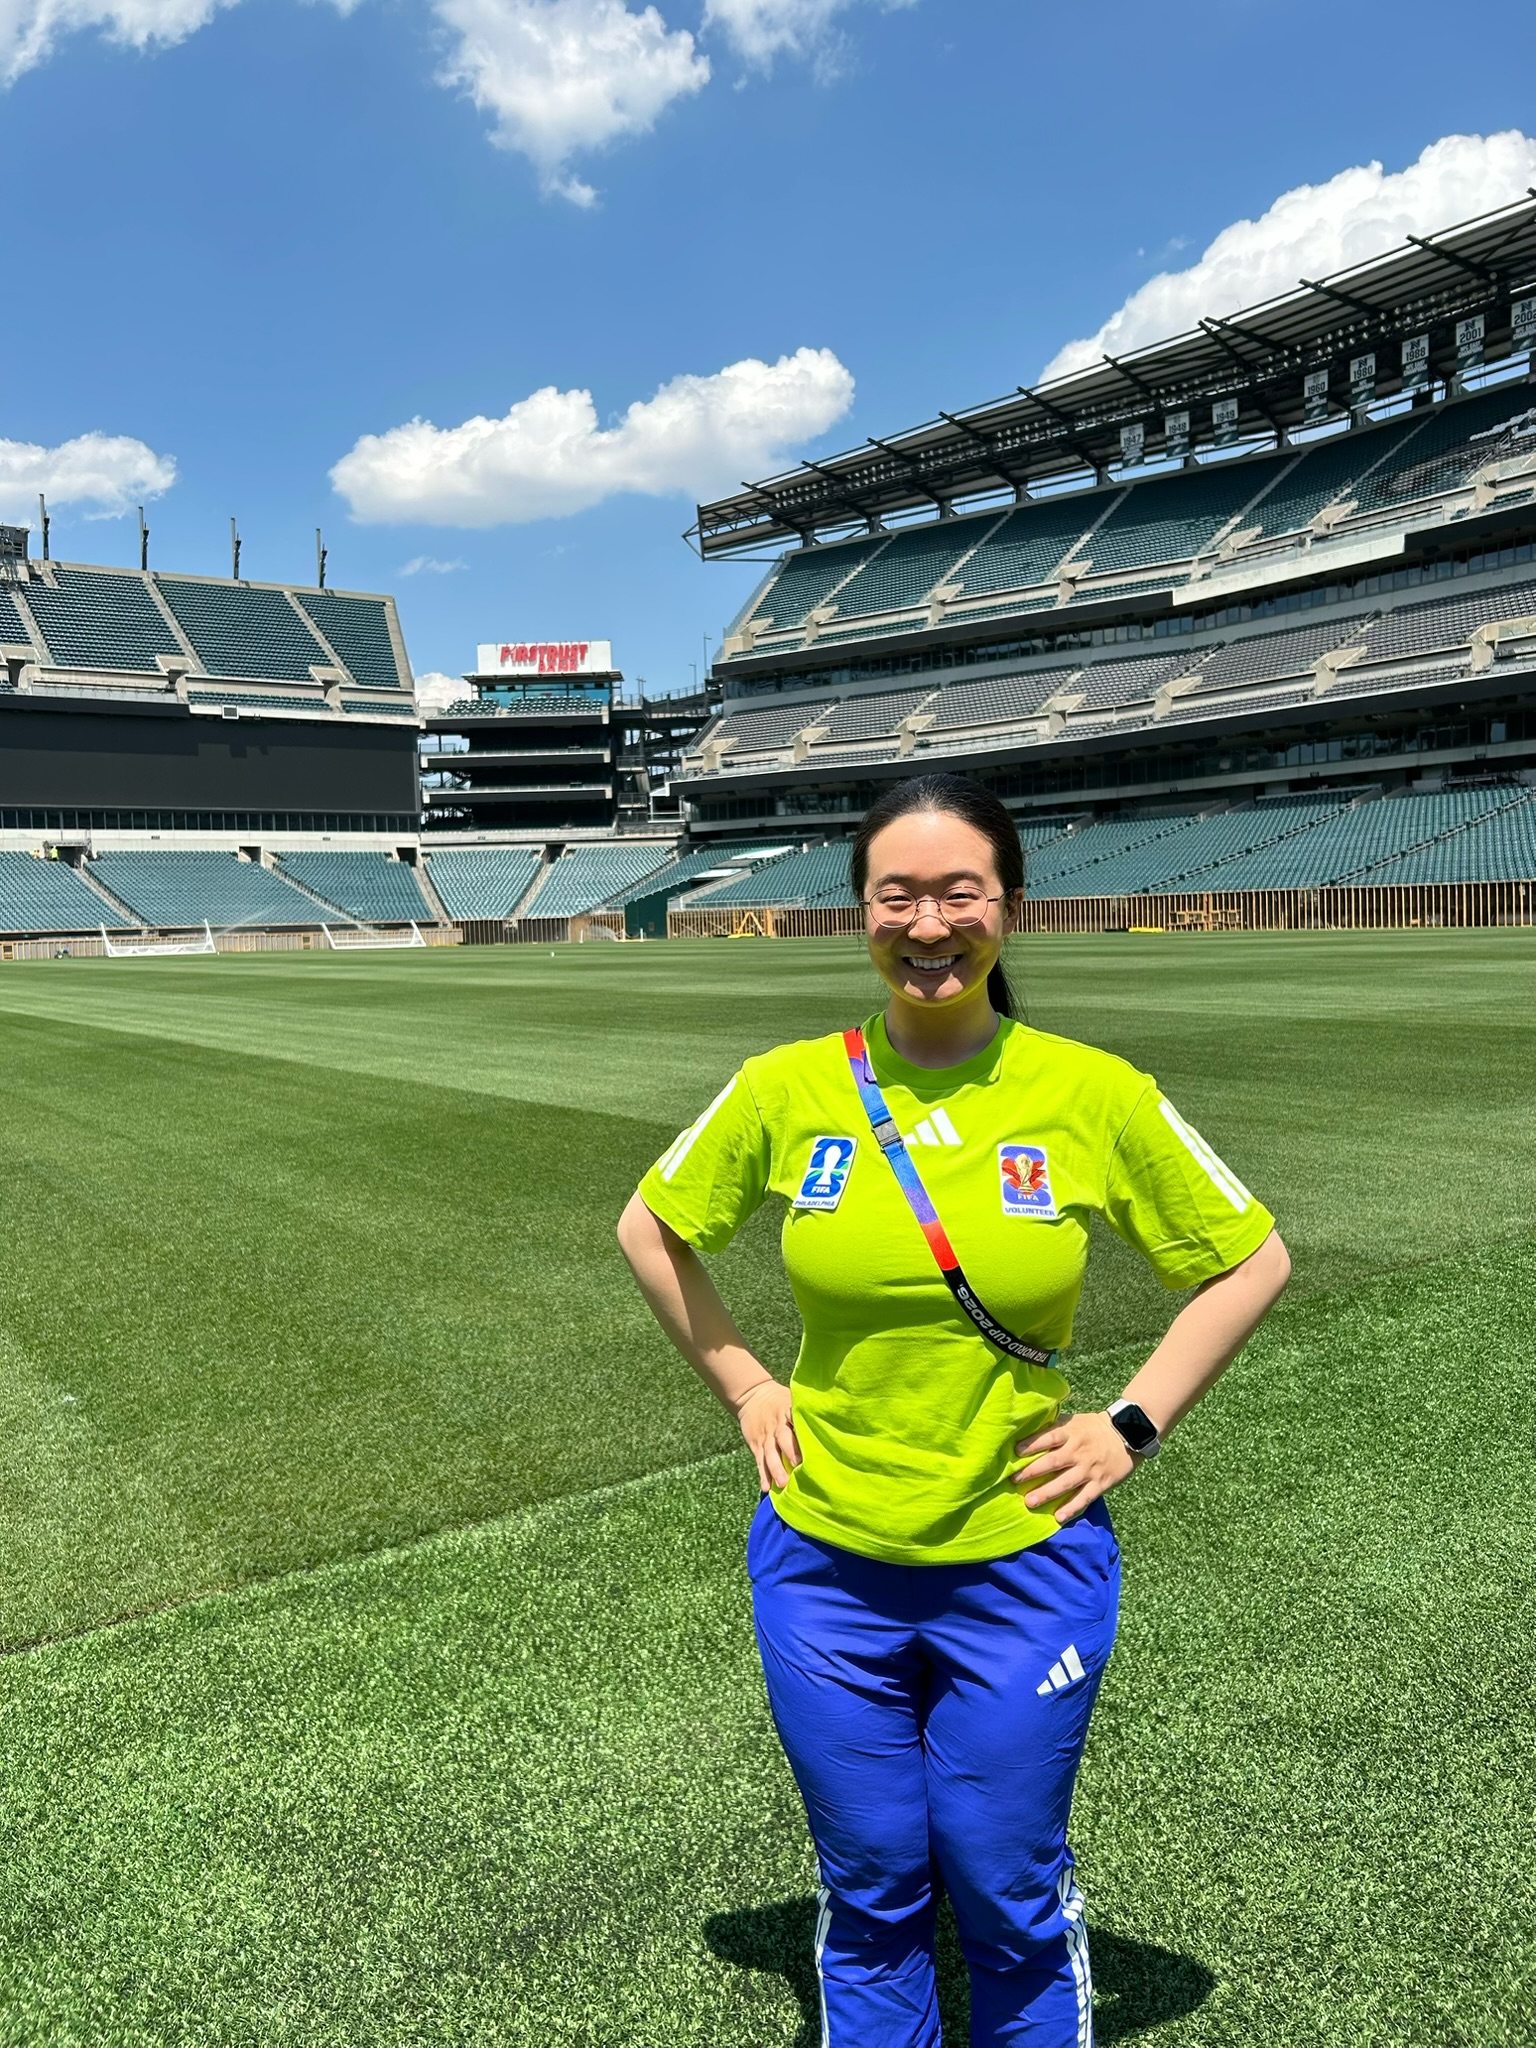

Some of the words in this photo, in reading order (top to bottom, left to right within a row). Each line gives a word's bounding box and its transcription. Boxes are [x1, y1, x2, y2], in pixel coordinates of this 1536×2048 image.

[1459, 327, 1482, 344] 2001
[1405, 346, 1426, 362] 1988
[1353, 365, 1373, 381] 1980
[1307, 381, 1326, 396] 1960
[538, 660, 578, 673] BANK
[810, 1185, 831, 1194] FIFA
[1017, 1194, 1039, 1202] FIFA
[1004, 1206, 1056, 1217] VOLUNTEER
[957, 1285, 994, 1330] 2026
[988, 1329, 1012, 1345] CUP
[1007, 1341, 1038, 1360] WORLD
